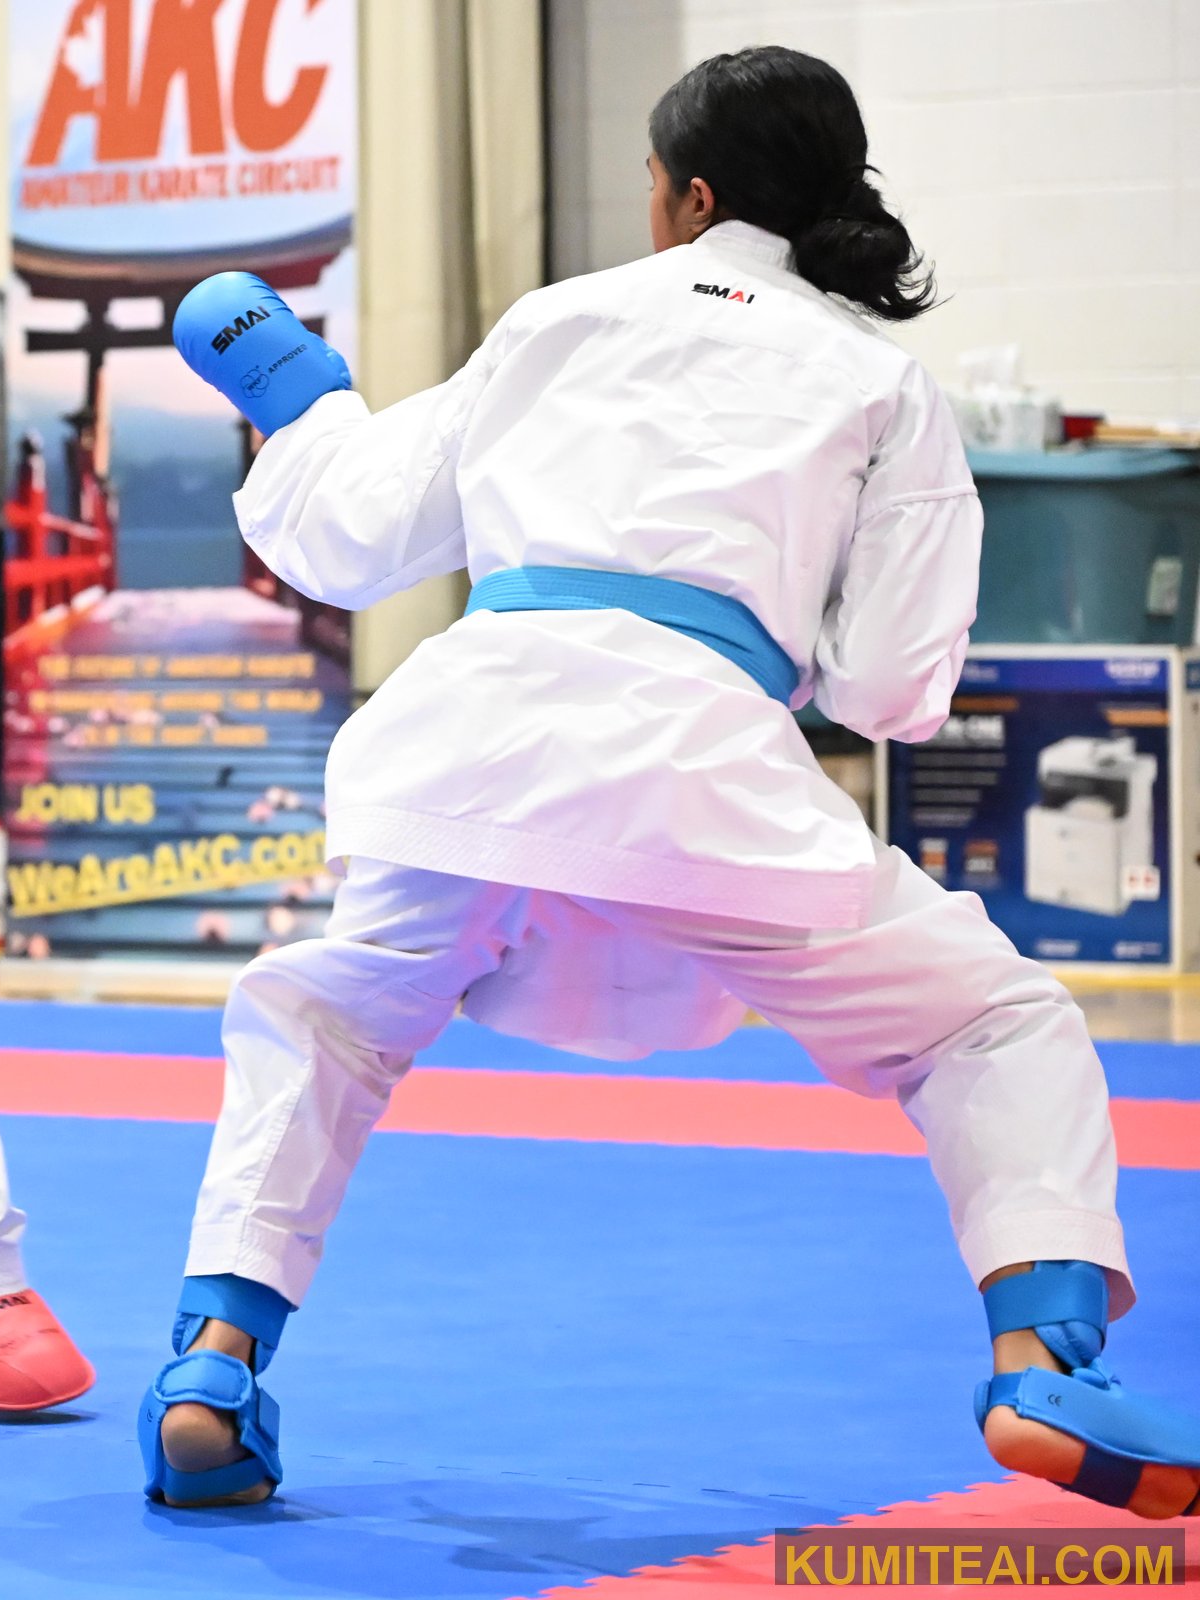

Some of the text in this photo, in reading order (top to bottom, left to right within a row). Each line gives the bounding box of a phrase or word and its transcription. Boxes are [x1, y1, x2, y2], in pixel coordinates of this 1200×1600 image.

[23, 0, 331, 168] AKC
[691, 283, 755, 304] SMAI
[211, 305, 271, 356] SMAI
[268, 343, 307, 374] APPROVED
[16, 782, 155, 824] JOIN US
